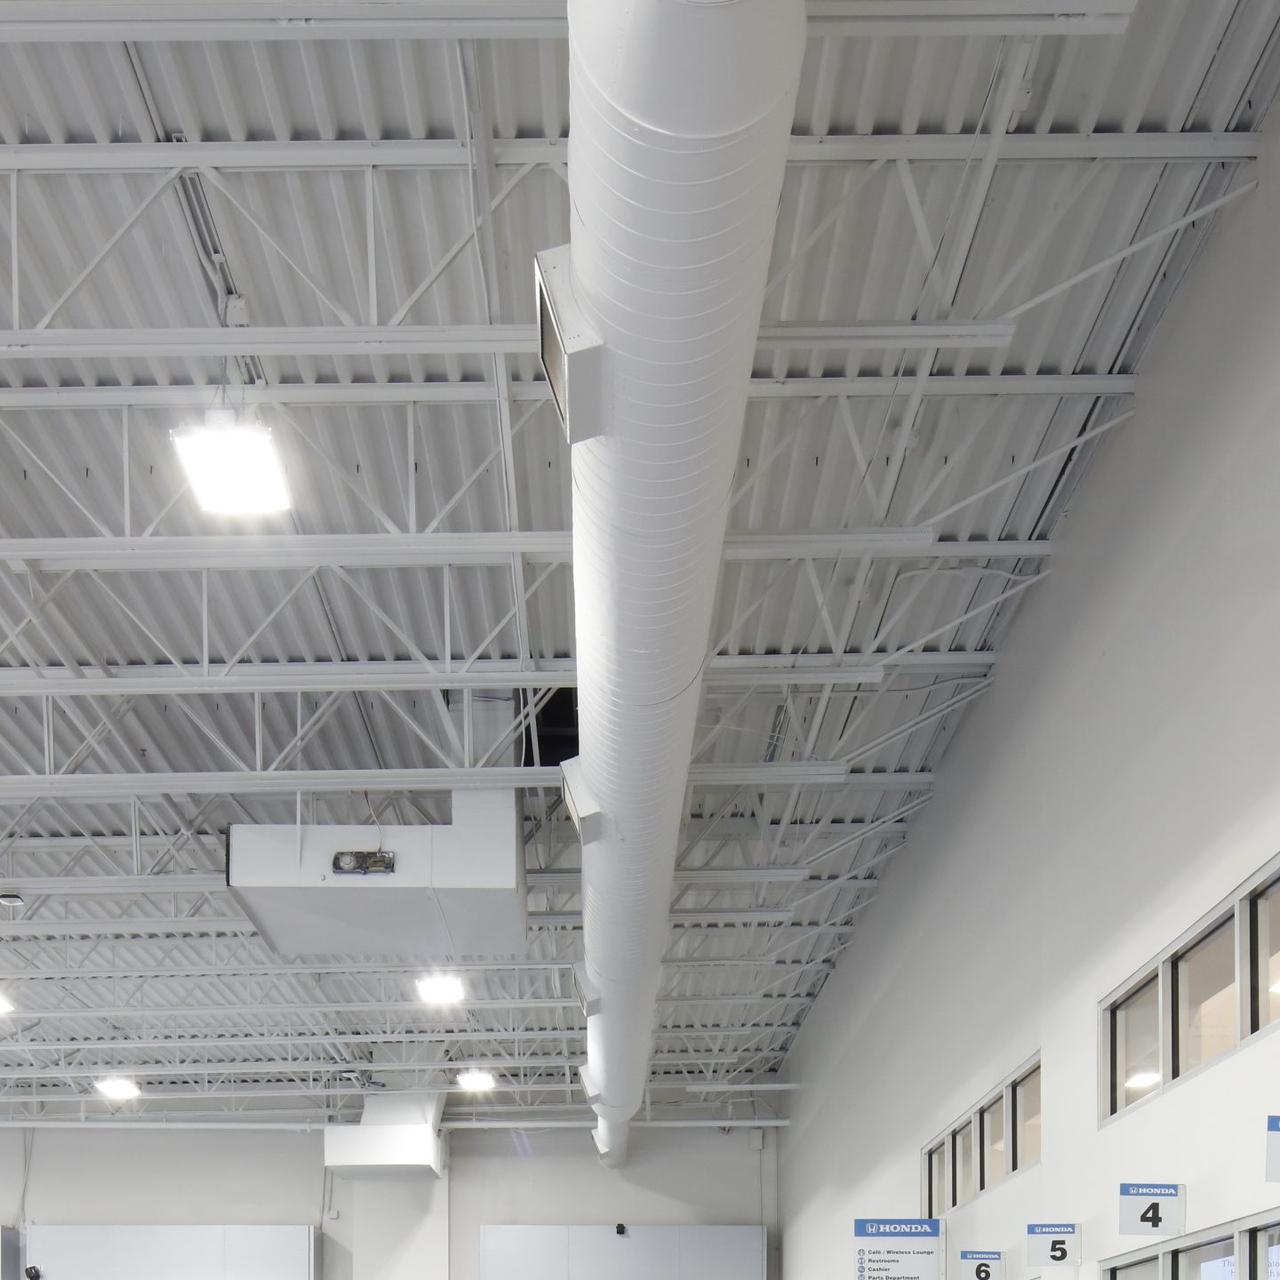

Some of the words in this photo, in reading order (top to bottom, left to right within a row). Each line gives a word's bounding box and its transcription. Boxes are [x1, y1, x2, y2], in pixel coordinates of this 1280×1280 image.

[1138, 1186, 1177, 1195] HONDA
[1139, 1202, 1163, 1228] 4
[879, 1224, 932, 1233] HONDA
[1049, 1239, 1068, 1261] 5
[975, 1262, 991, 1280] 6
